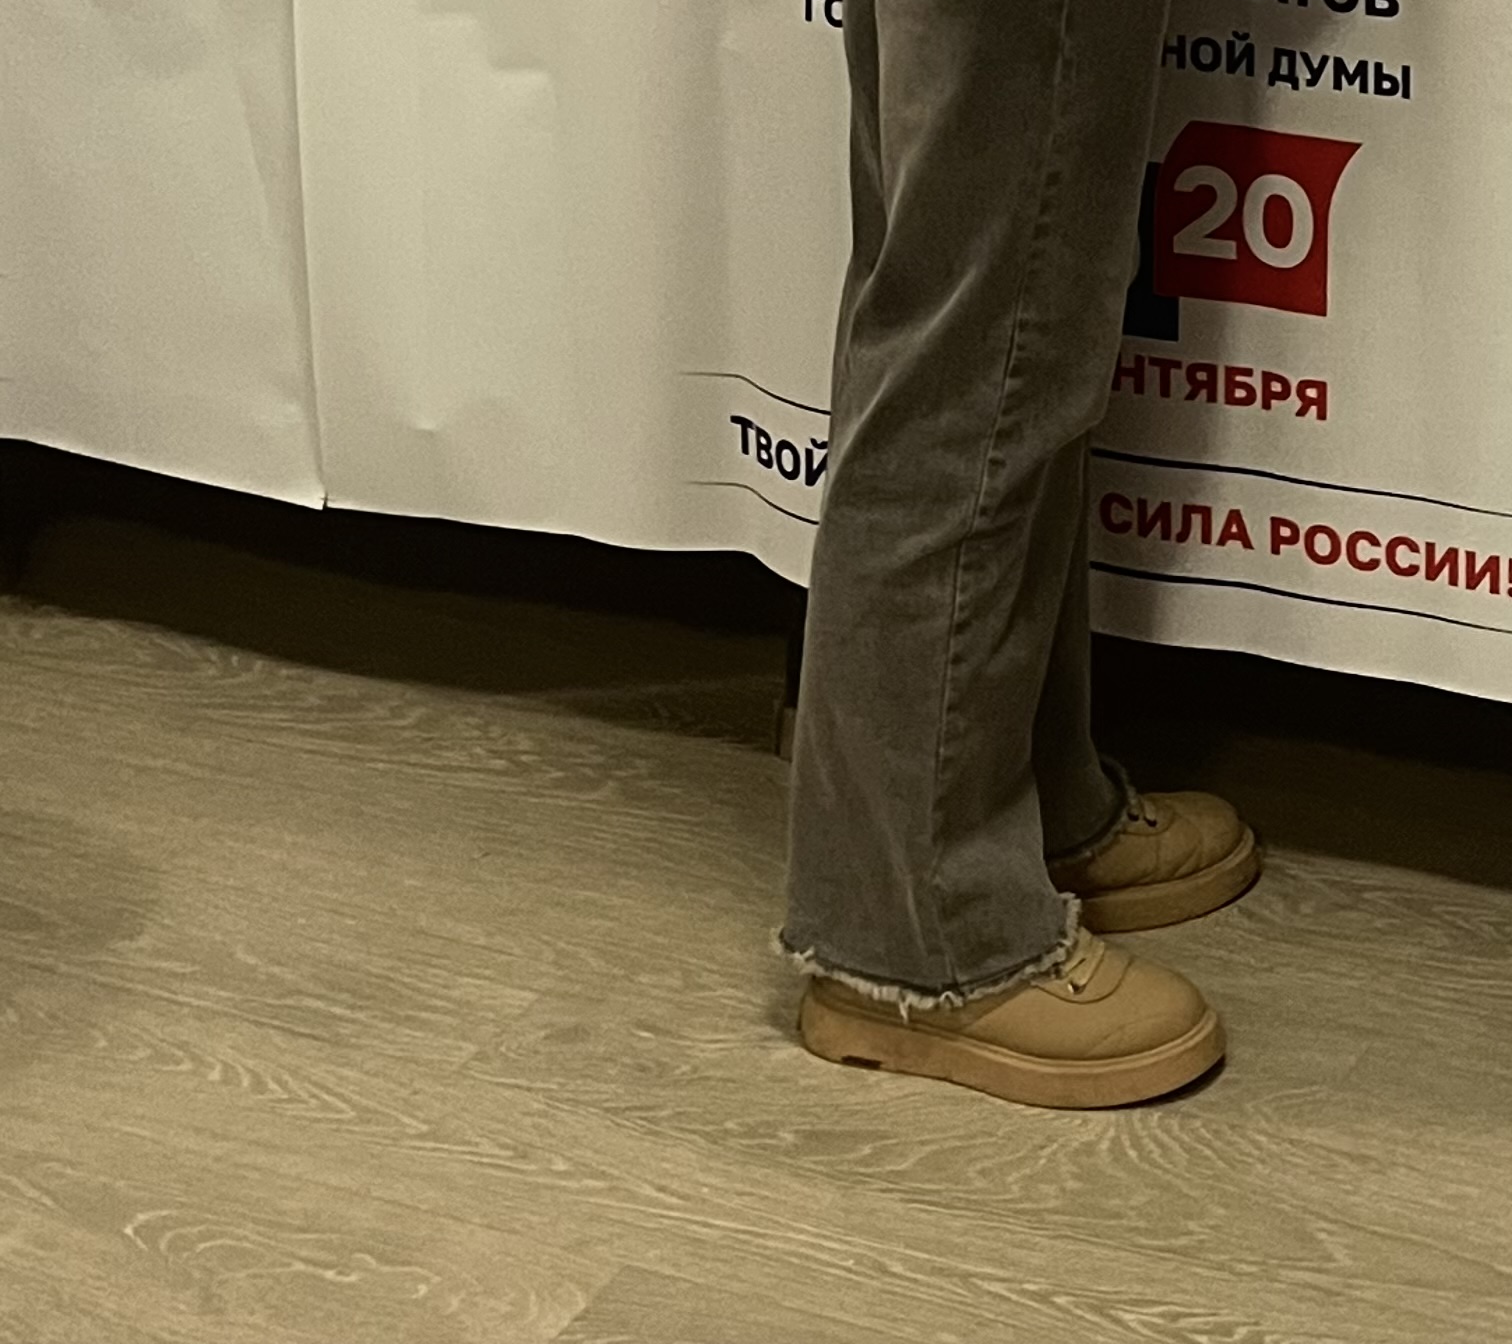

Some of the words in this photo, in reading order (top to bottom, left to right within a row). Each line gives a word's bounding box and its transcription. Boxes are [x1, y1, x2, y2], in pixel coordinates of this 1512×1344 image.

[1267, 47, 1411, 100] ДУМЫ
[1173, 165, 1314, 269] 20
[1111, 351, 1328, 421] НТЯБРЯ
[729, 415, 829, 487] ТВОЙ
[1100, 492, 1255, 551] СИЛА
